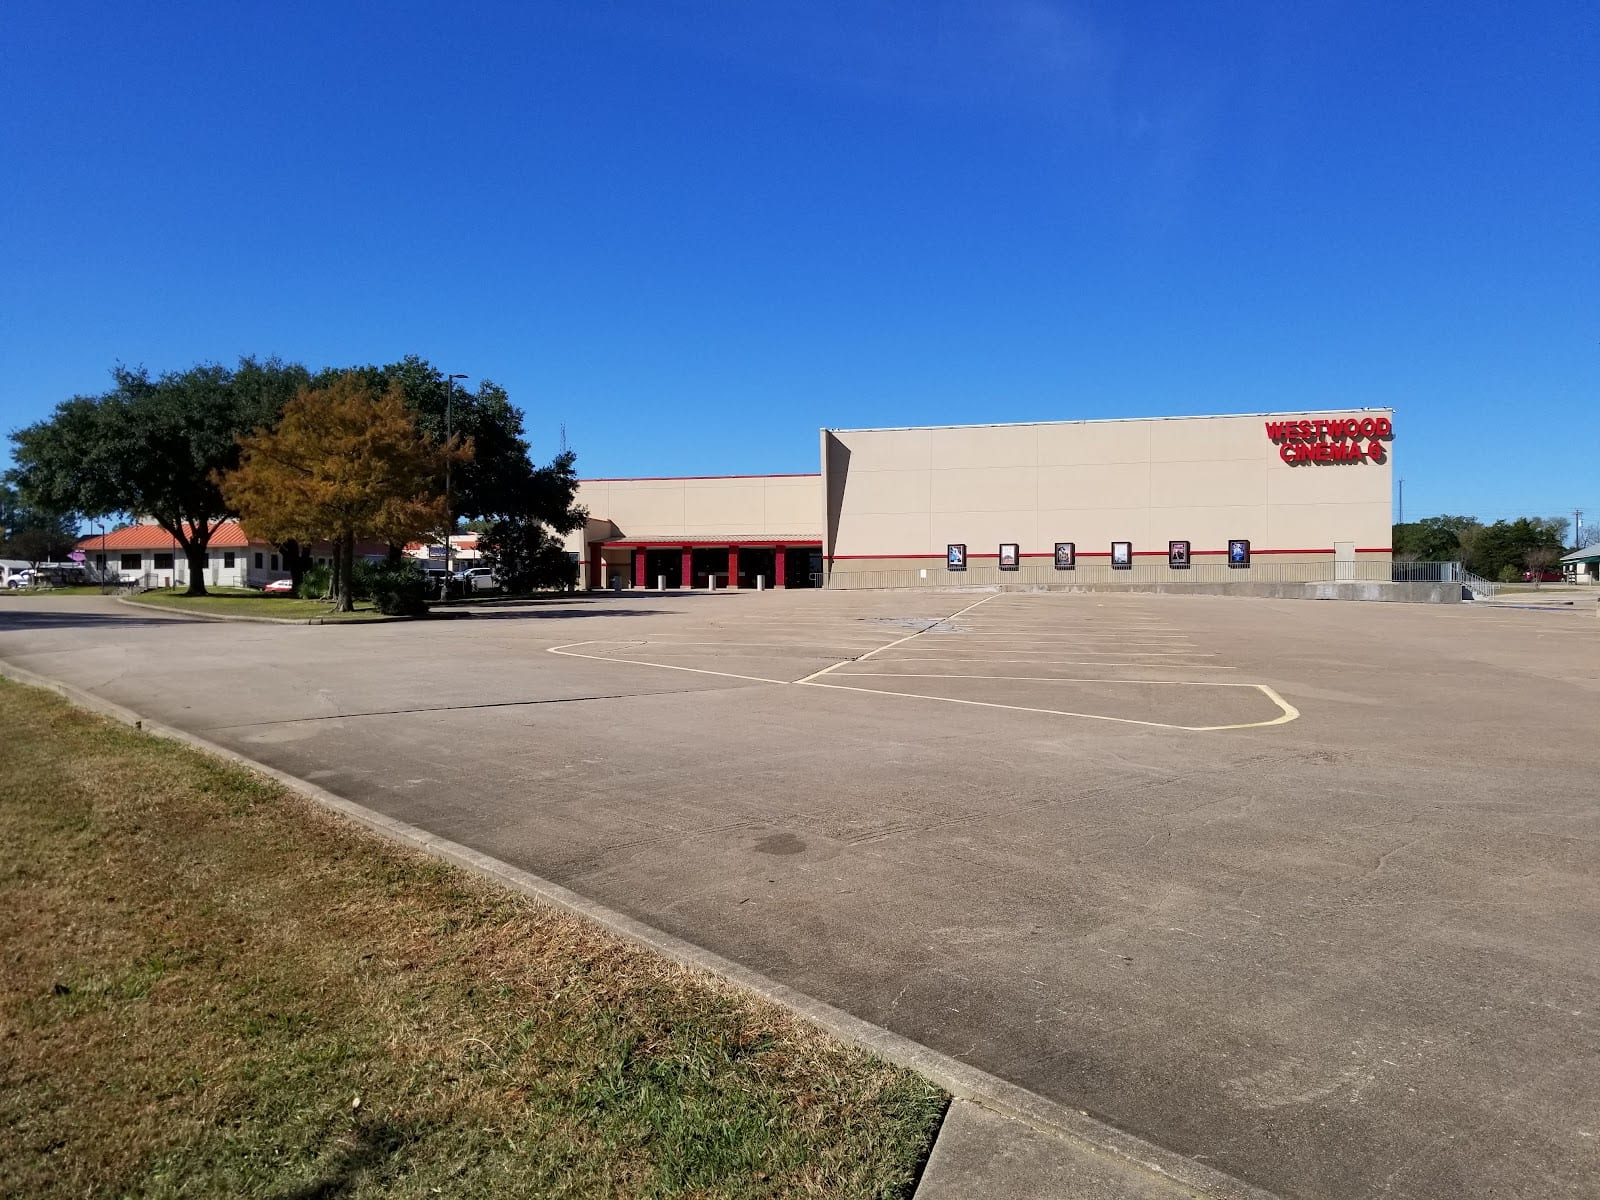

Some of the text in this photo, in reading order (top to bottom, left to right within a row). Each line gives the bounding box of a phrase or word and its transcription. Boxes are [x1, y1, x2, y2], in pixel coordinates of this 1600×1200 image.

[1265, 418, 1391, 439] WESTWOOD
[1280, 440, 1382, 462] CINEMA 6
